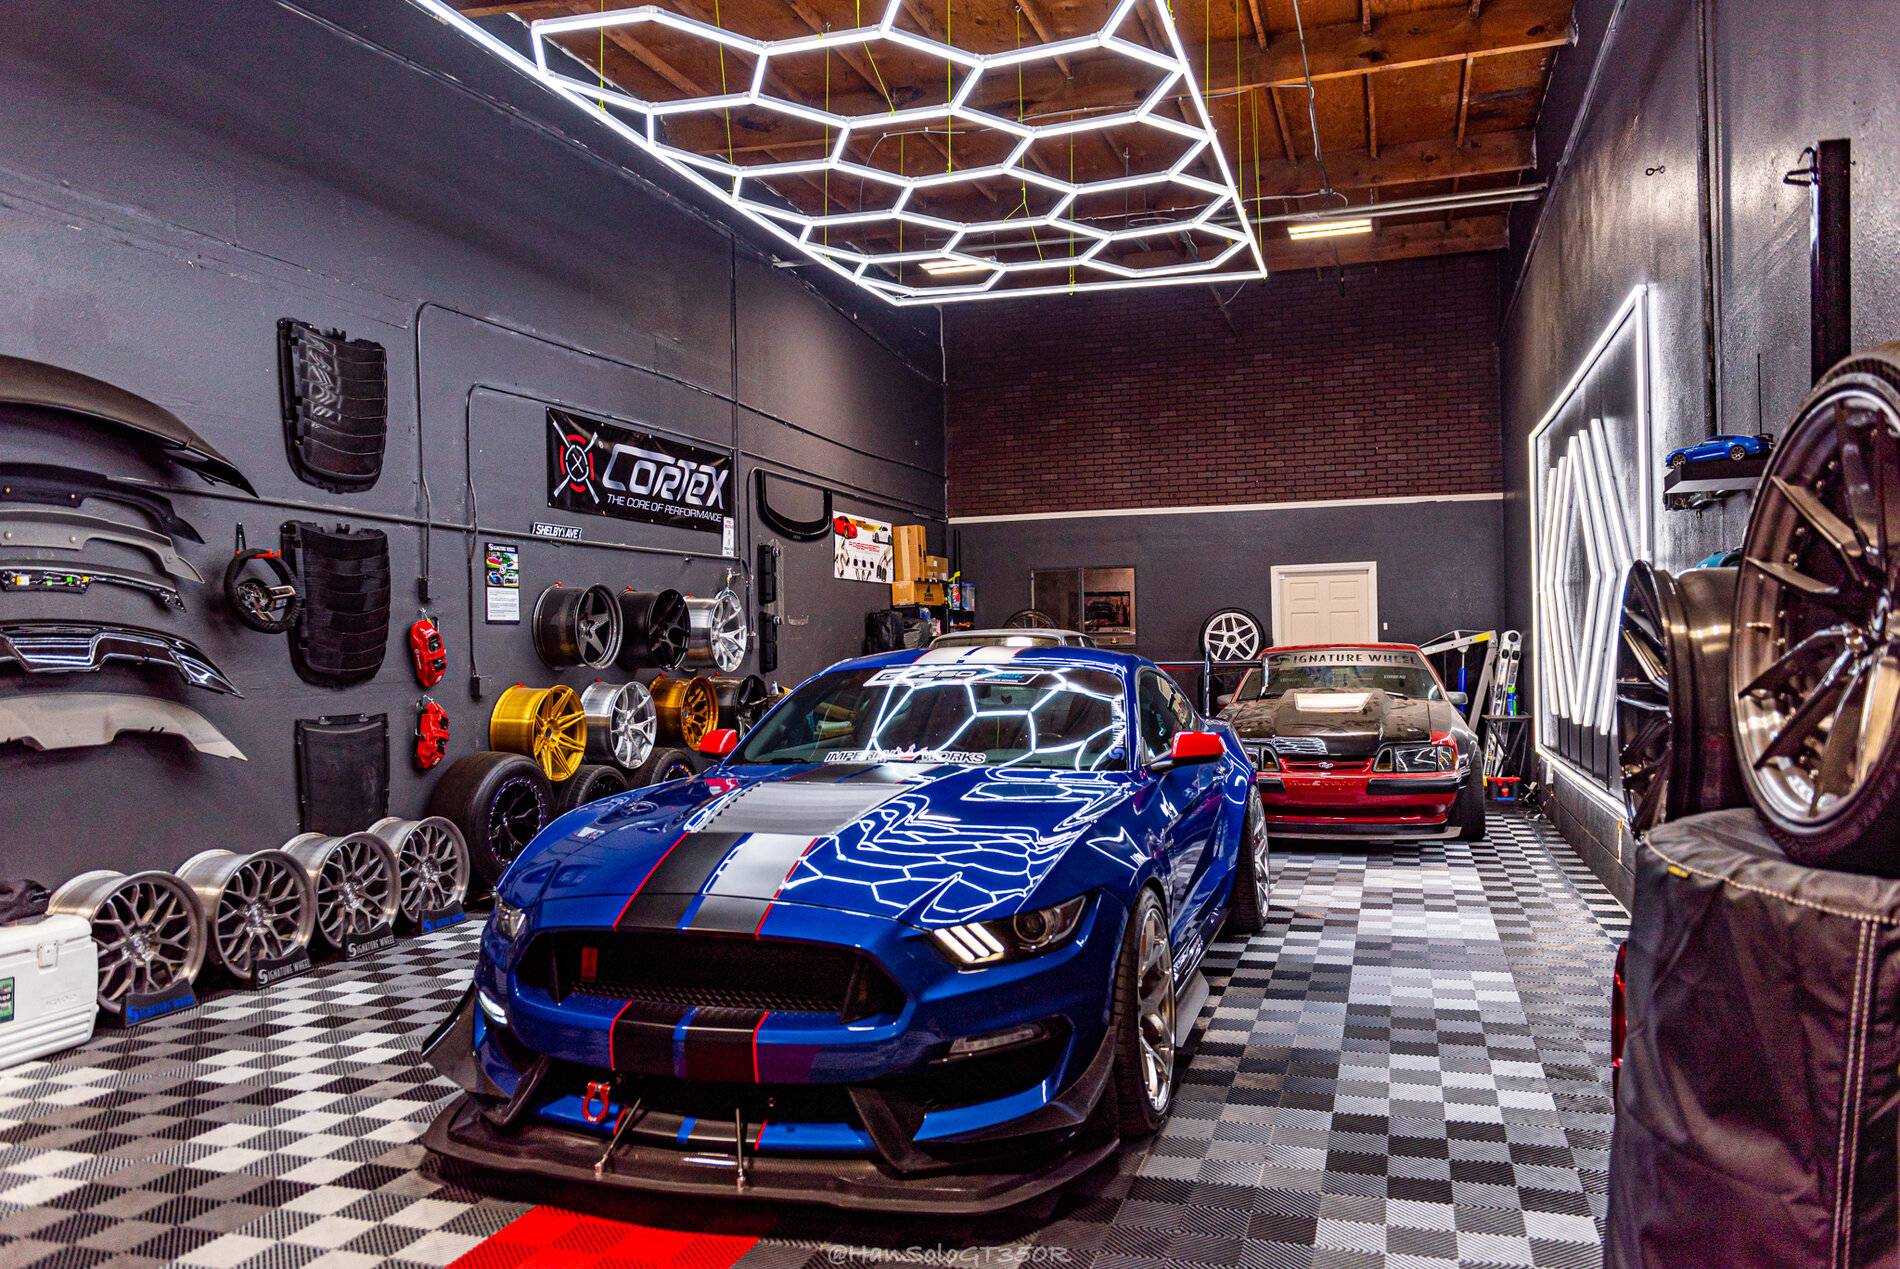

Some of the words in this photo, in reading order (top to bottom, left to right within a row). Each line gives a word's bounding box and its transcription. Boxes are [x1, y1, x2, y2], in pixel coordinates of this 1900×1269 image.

[607, 493, 625, 506] THE
[626, 497, 651, 511] CORE
[651, 502, 664, 512] OF
[664, 504, 722, 523] PERFORMANCE
[535, 524, 562, 537] SHELBY
[565, 528, 579, 539] AVE
